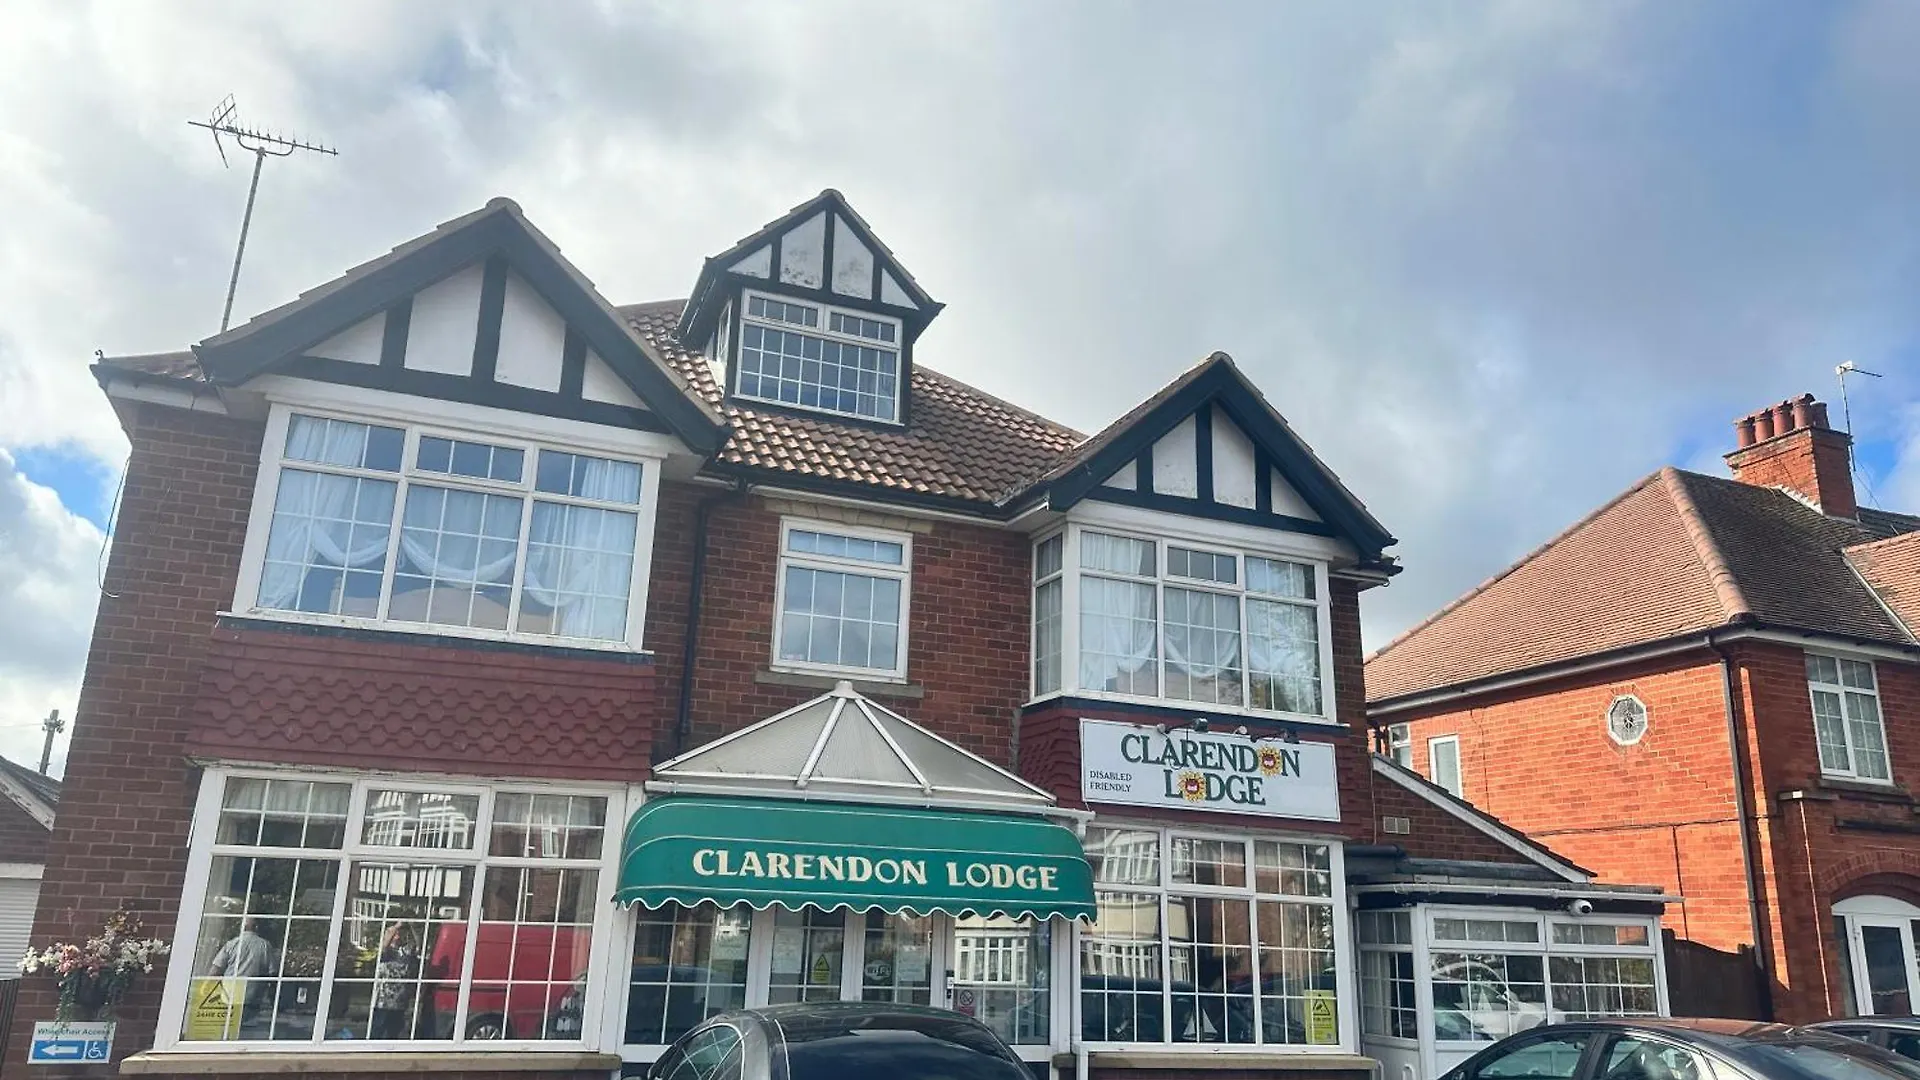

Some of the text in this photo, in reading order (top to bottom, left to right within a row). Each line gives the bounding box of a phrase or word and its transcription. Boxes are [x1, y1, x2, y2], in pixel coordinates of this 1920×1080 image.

[1089, 770, 1132, 781] DISABLED
[1089, 781, 1132, 793] FRIENDLY
[692, 848, 1059, 892] CLARENDON LODGE
